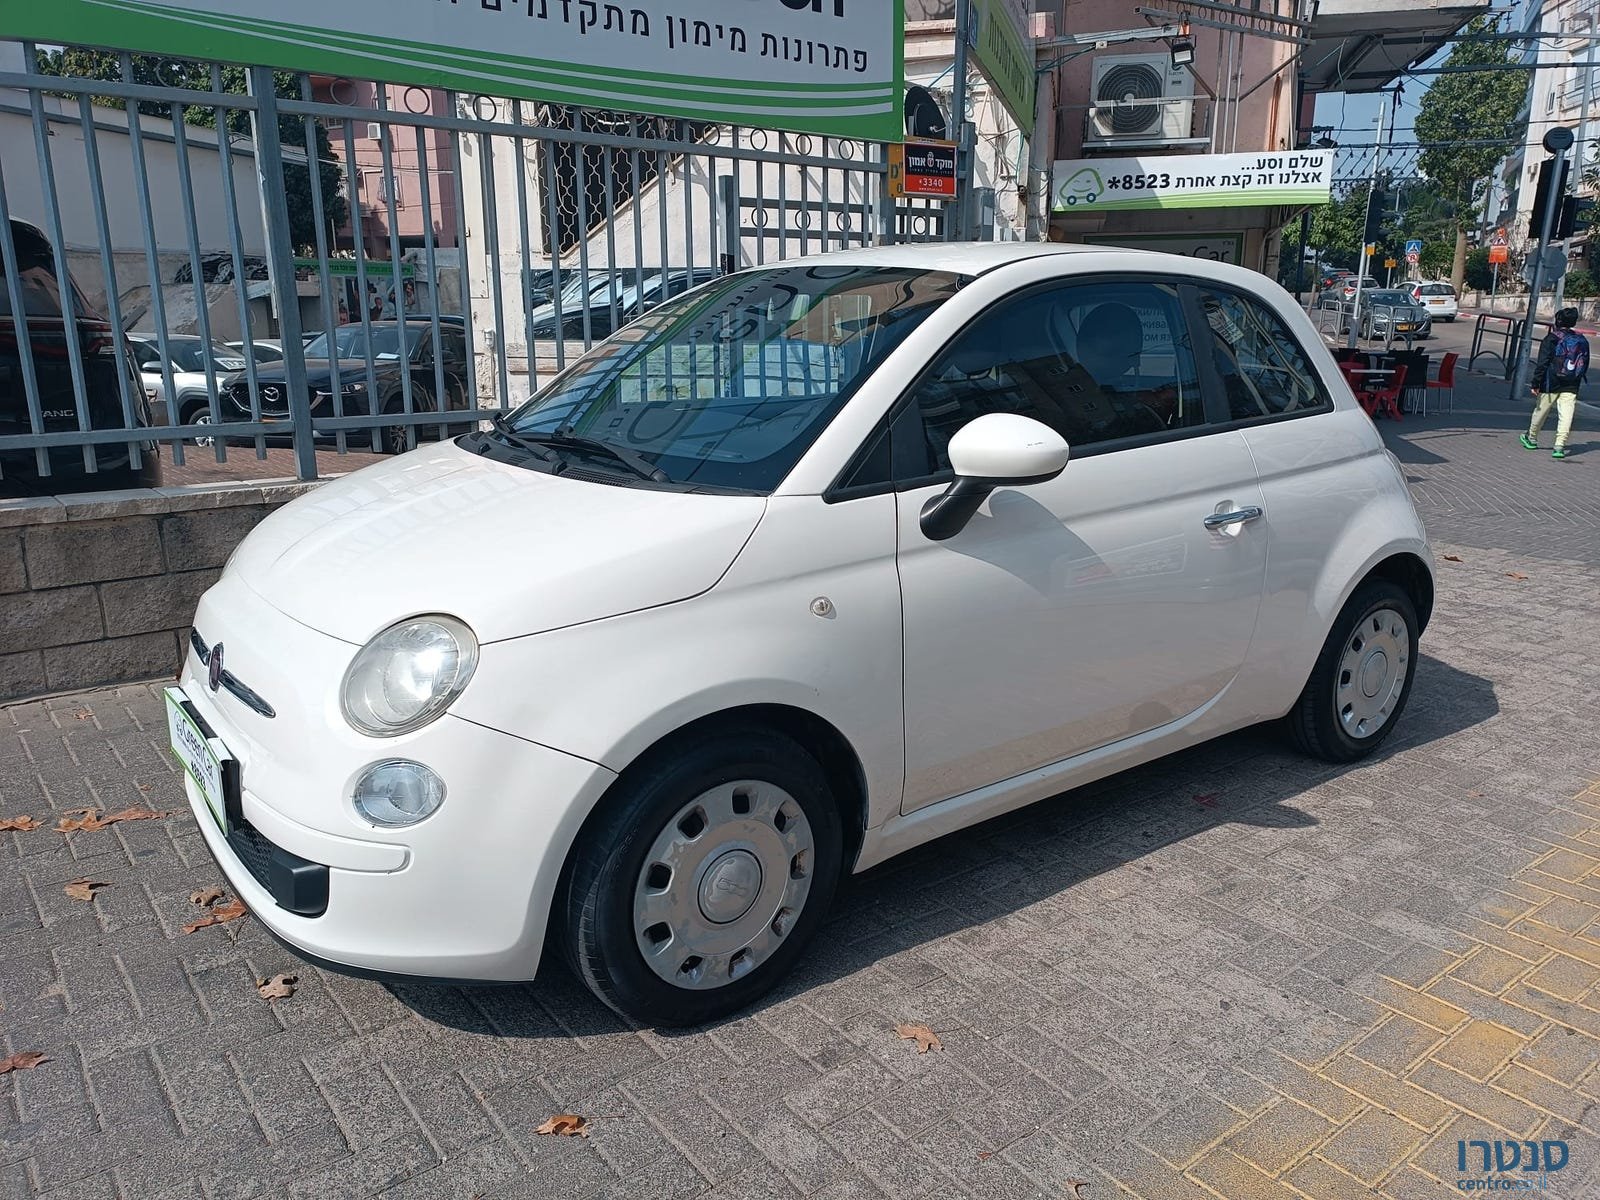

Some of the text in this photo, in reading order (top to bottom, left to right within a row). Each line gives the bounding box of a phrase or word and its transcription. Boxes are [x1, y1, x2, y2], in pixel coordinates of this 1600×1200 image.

[481, 0, 867, 73] פתרונות מימון מתקדמ
[908, 156, 953, 170] מוקד אמון
[1288, 154, 1323, 169] שלם
[1175, 175, 1216, 188] אחרת
[1220, 174, 1252, 189] קצת
[1257, 173, 1274, 185] זה
[1279, 170, 1322, 184] אצלנו
[41, 409, 74, 418] ANG
